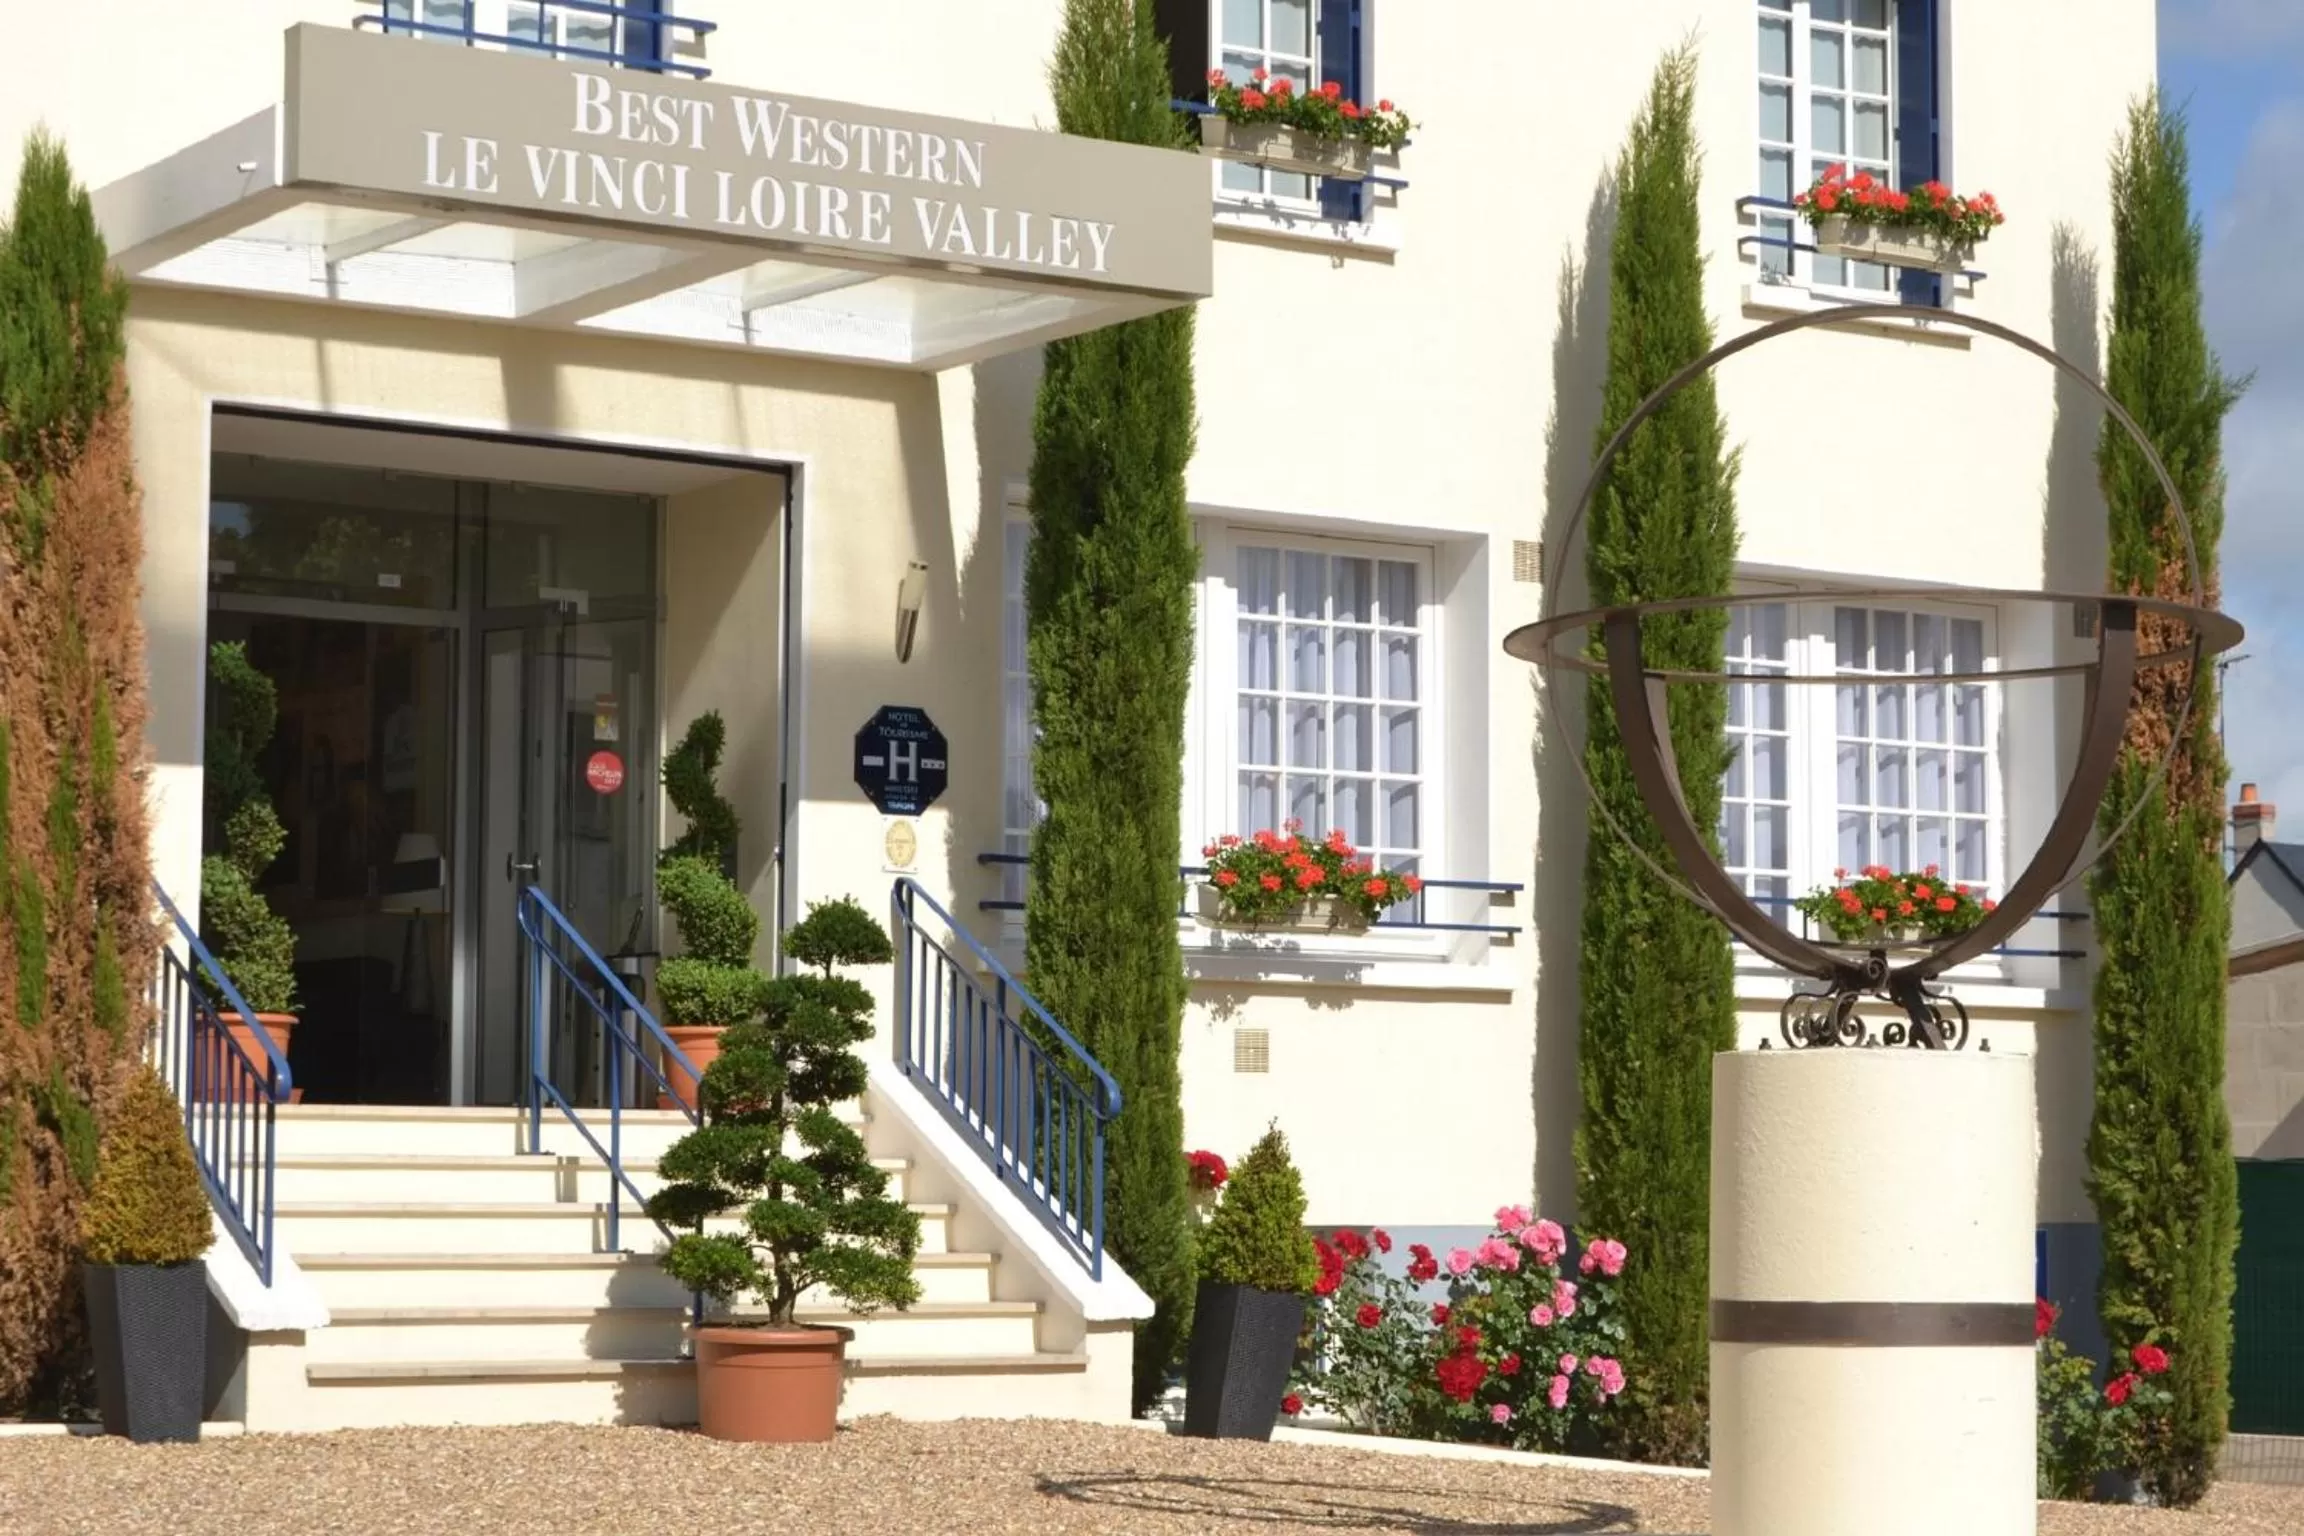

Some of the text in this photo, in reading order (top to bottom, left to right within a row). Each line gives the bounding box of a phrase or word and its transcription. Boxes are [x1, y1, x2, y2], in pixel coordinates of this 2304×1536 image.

[571, 72, 985, 189] BEST WESTERN
[422, 131, 1115, 273] LE VINCI LOIRE VALLEY
[887, 740, 919, 783] H
